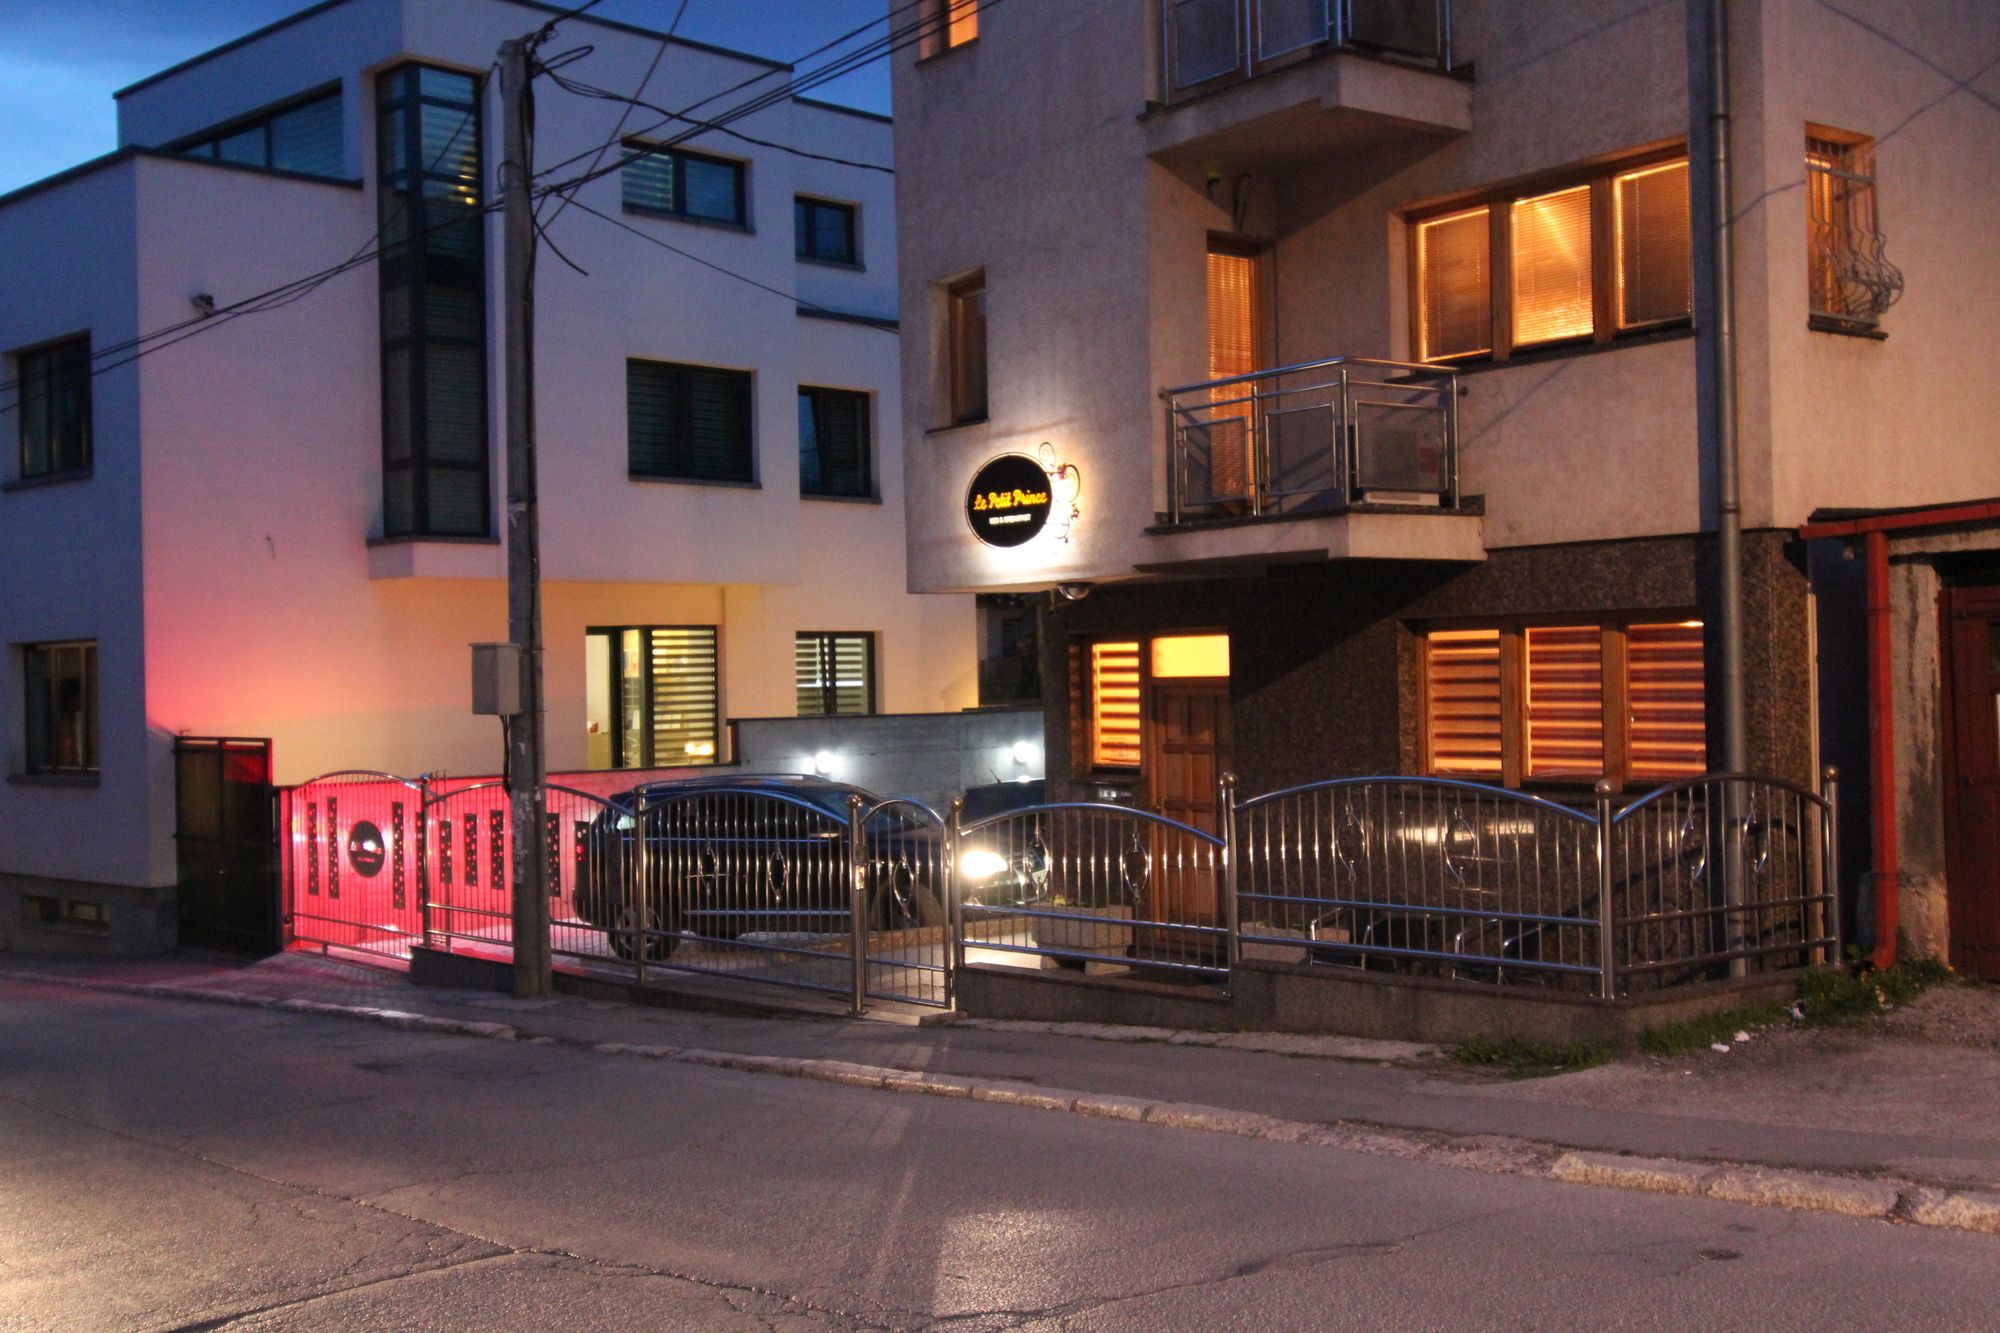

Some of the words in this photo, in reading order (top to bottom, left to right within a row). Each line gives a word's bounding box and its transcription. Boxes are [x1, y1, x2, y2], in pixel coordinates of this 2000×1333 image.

[973, 494, 987, 510] Le
[988, 492, 1012, 509] Petit
[1013, 489, 1048, 506] Prince
